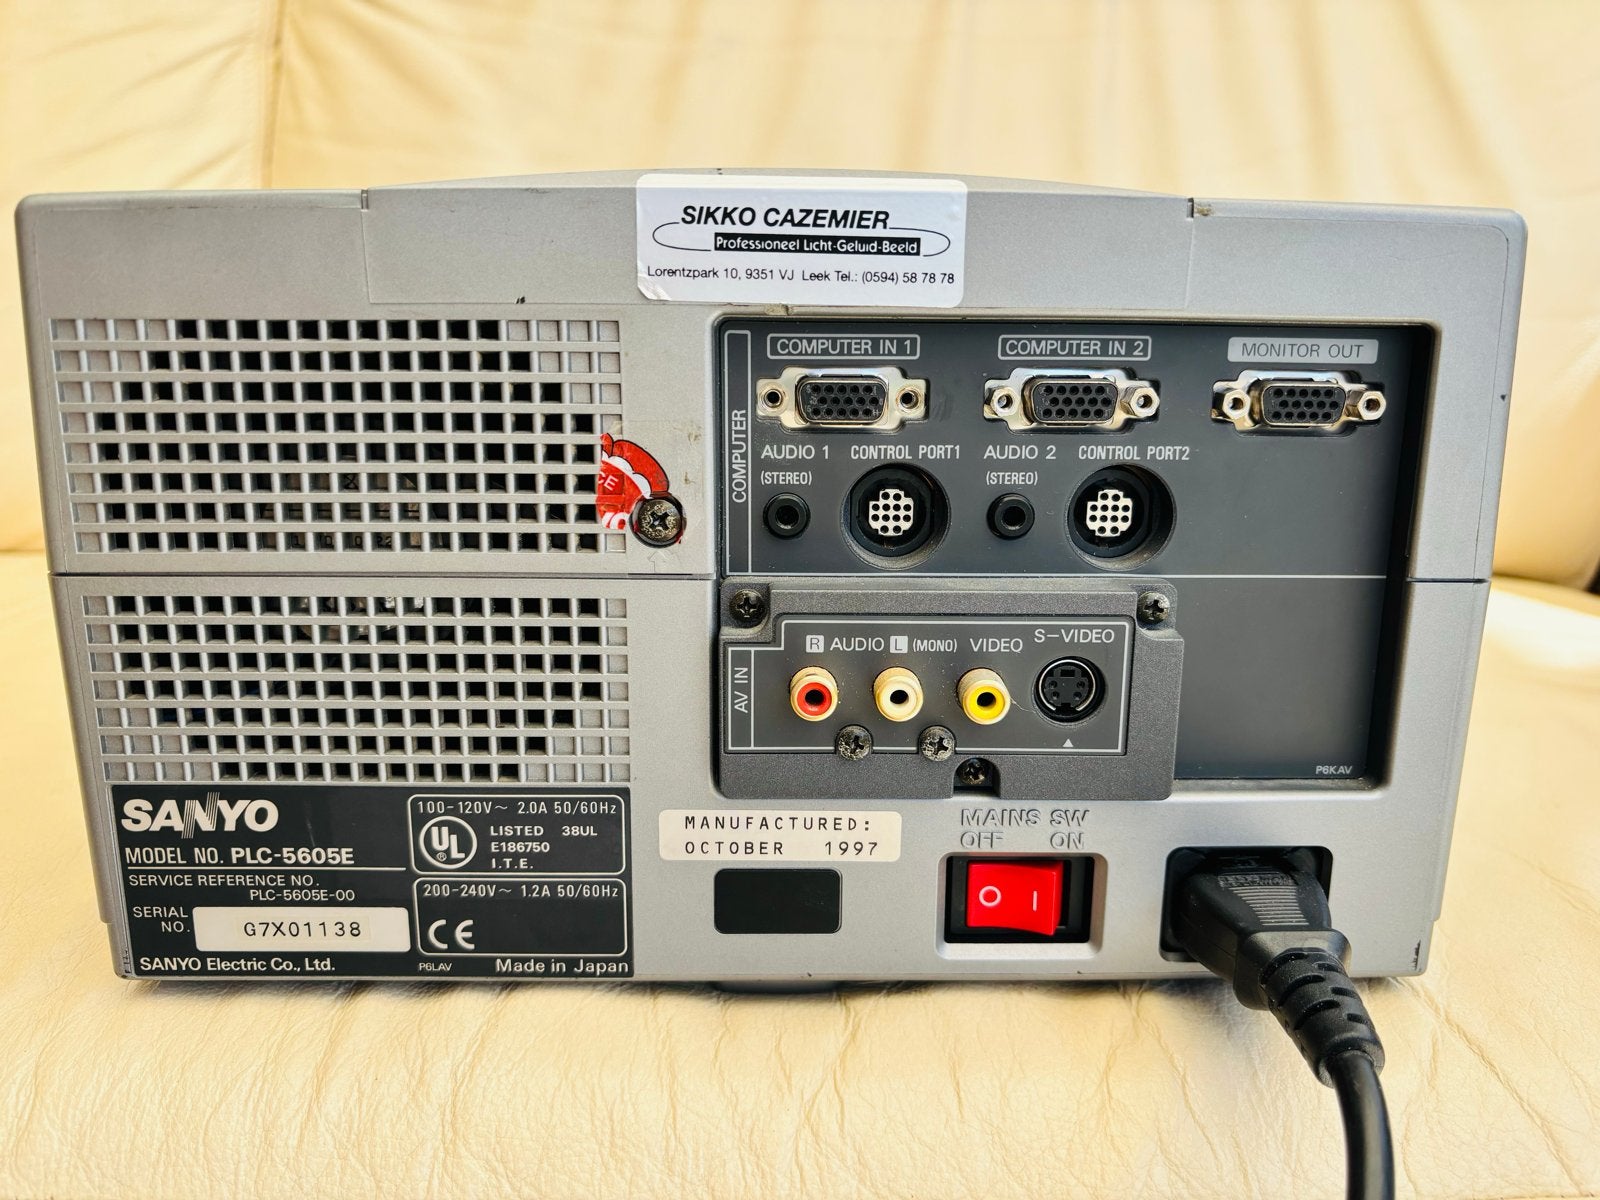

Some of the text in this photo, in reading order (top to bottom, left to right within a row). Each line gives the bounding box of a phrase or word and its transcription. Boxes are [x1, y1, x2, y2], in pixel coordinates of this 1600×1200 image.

[681, 205, 890, 230] SIKKO CAZEMIER
[715, 236, 918, 254] Professioneel Licht-Geluid-Beeld
[647, 266, 955, 285] Lorentzpark 10, 9351 VJ Leek Tel.: (0594) 58 78 78
[776, 338, 912, 355] COMPUTER IN 1
[1005, 340, 1144, 357] COMPUTER IN 2
[1241, 343, 1365, 358] MONITOR OUT
[732, 409, 747, 503] COMPUTER
[760, 445, 829, 460] AUDIO 1
[850, 444, 913, 461] CONTROL
[983, 445, 1057, 460] AUDIO 2
[1078, 446, 1141, 461] CONTROL
[760, 470, 813, 486] (STEREO)
[985, 470, 1039, 486] (STEREO)
[1033, 629, 1115, 644] S-VIDEO
[808, 637, 822, 651] R
[829, 637, 886, 652] AUDIO
[912, 639, 958, 653] (MONO)
[969, 638, 1024, 653] VIDEO
[733, 666, 749, 714] AV IN
[1315, 765, 1353, 775] P6KAV
[121, 791, 279, 839] SANYO
[517, 800, 548, 815] 2.0A
[554, 800, 617, 816] 50/60Hz
[684, 815, 872, 831] MANUFACTURED:
[960, 808, 1090, 827] MAINS SW
[490, 826, 598, 836] LISTED 38UL
[491, 842, 550, 853] E186750
[684, 840, 880, 857] OCTOBER 1997
[960, 831, 1085, 850] OFF ON
[125, 847, 355, 865] MODEL NO. PLC-5605E
[492, 858, 534, 869] I.T.E.
[128, 874, 320, 887] SERVICE REFERENCE NO.
[250, 889, 355, 901] PLC-5605E-00
[520, 884, 551, 898] 1.2A
[557, 884, 619, 899] 50/60Hz
[133, 906, 189, 918] SERIAL
[161, 921, 190, 933] NO.
[243, 922, 362, 937] G7X01138
[427, 919, 475, 950] CE
[140, 957, 336, 973] SANYO Electric Co., Ltd.
[418, 962, 453, 972] P6LAV
[495, 959, 629, 976] Made in Japan
